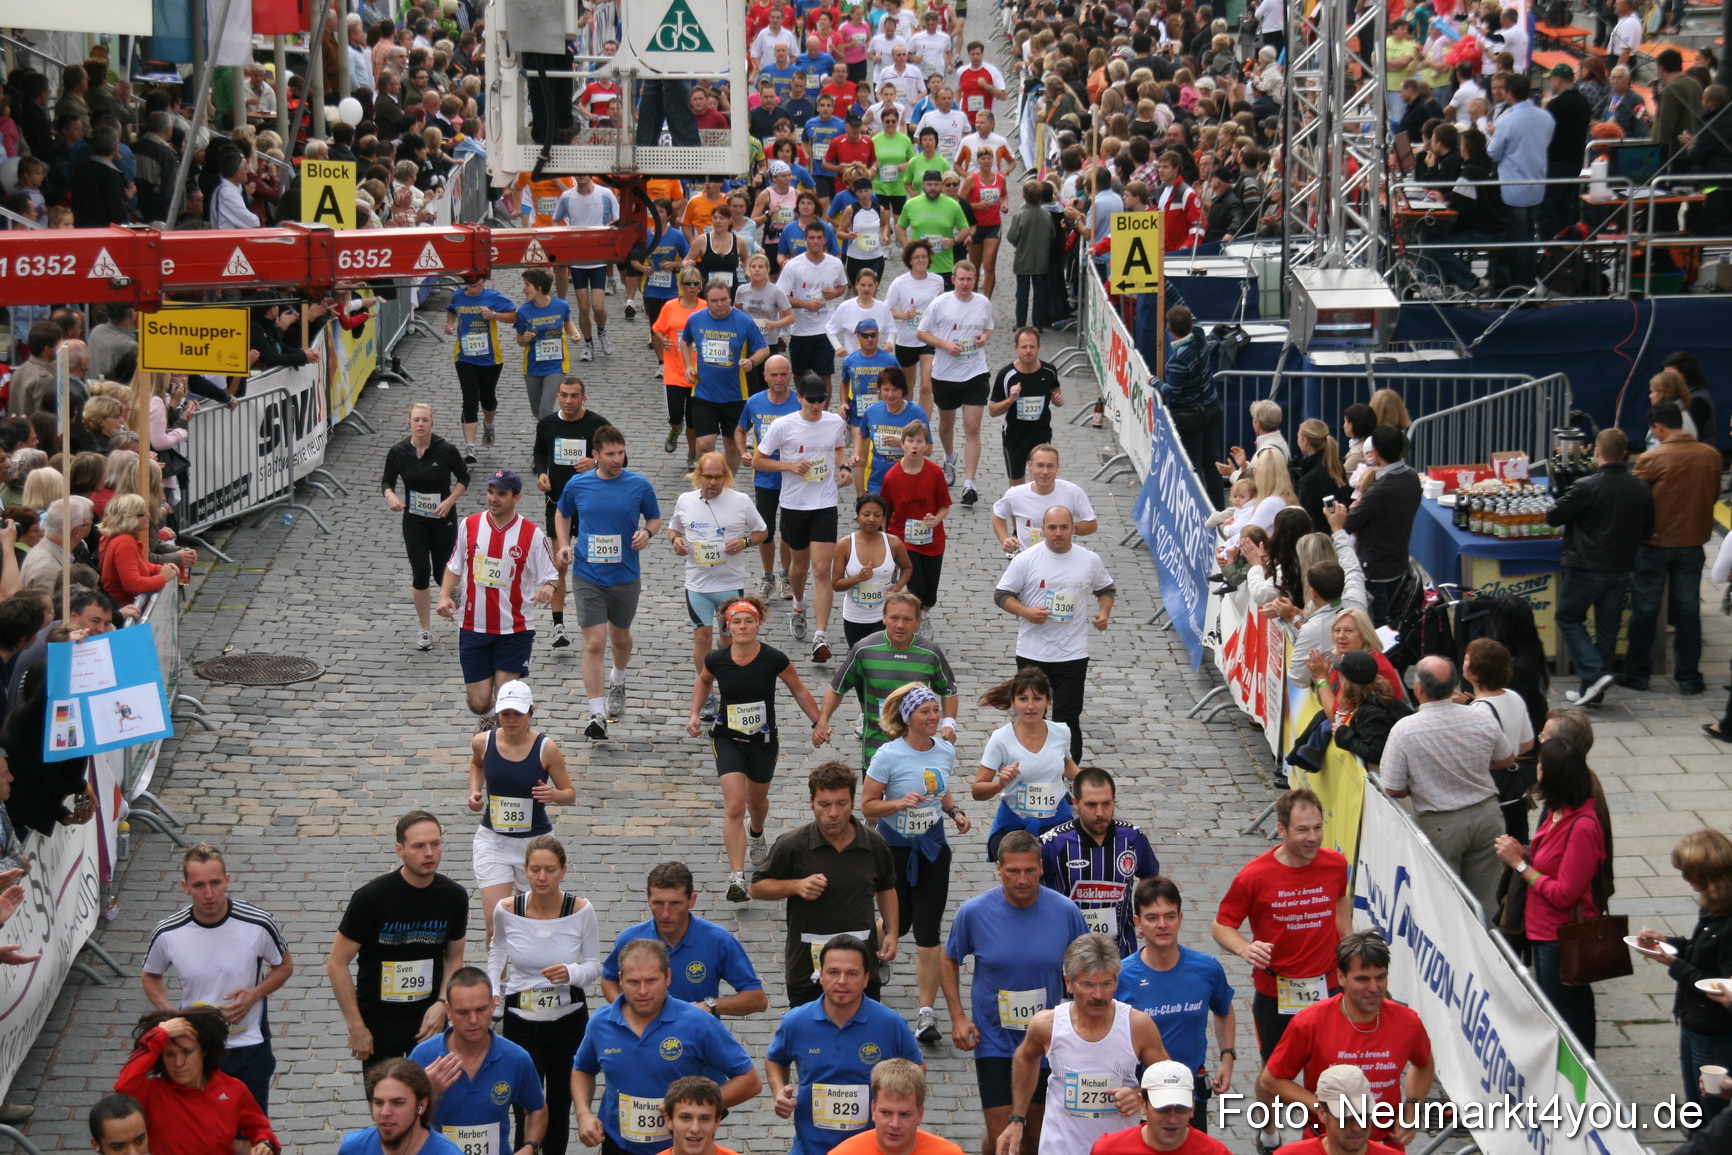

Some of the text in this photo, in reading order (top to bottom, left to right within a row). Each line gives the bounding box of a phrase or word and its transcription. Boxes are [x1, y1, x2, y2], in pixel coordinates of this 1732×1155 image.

[307, 163, 350, 182] Block
[313, 185, 345, 224] A
[1117, 215, 1158, 231] Block
[338, 248, 392, 269] 6352
[1121, 236, 1153, 277] A
[16, 257, 77, 277] 6352
[148, 321, 242, 341] Schnupper-
[180, 342, 210, 357] lauf
[469, 342, 486, 350] 2512
[708, 348, 726, 356] 2108
[1025, 404, 1041, 413] 2321
[563, 449, 583, 457] 3880
[814, 464, 828, 475] 782
[417, 502, 437, 510] 2609
[596, 536, 614, 544] Richard
[596, 546, 619, 555] 2019
[704, 551, 720, 560] 421
[484, 559, 499, 567] Bernd
[489, 569, 501, 579] 20
[861, 592, 881, 600] 3908
[736, 705, 761, 715] Christine
[742, 714, 761, 726] 808
[500, 799, 520, 808] Verena
[1029, 795, 1055, 805] 3115
[503, 811, 525, 822] 383
[908, 820, 934, 831] 3114
[1302, 886, 1323, 896] brennt
[1304, 909, 1332, 919] Feuerwehr
[396, 964, 413, 974] Sven
[401, 976, 425, 989] 299
[1289, 980, 1307, 988] Erich
[1296, 991, 1321, 1001] 112
[538, 995, 562, 1008] 471
[1184, 1000, 1203, 1012] Lauf
[1364, 1049, 1390, 1058] brennt
[1081, 1078, 1108, 1087] Michael
[827, 1087, 858, 1098] Andreas
[632, 1099, 660, 1111] Markus
[832, 1103, 860, 1115] 829
[638, 1115, 665, 1128] 830
[458, 1129, 488, 1139] Herbert
[464, 1142, 490, 1155] 831
